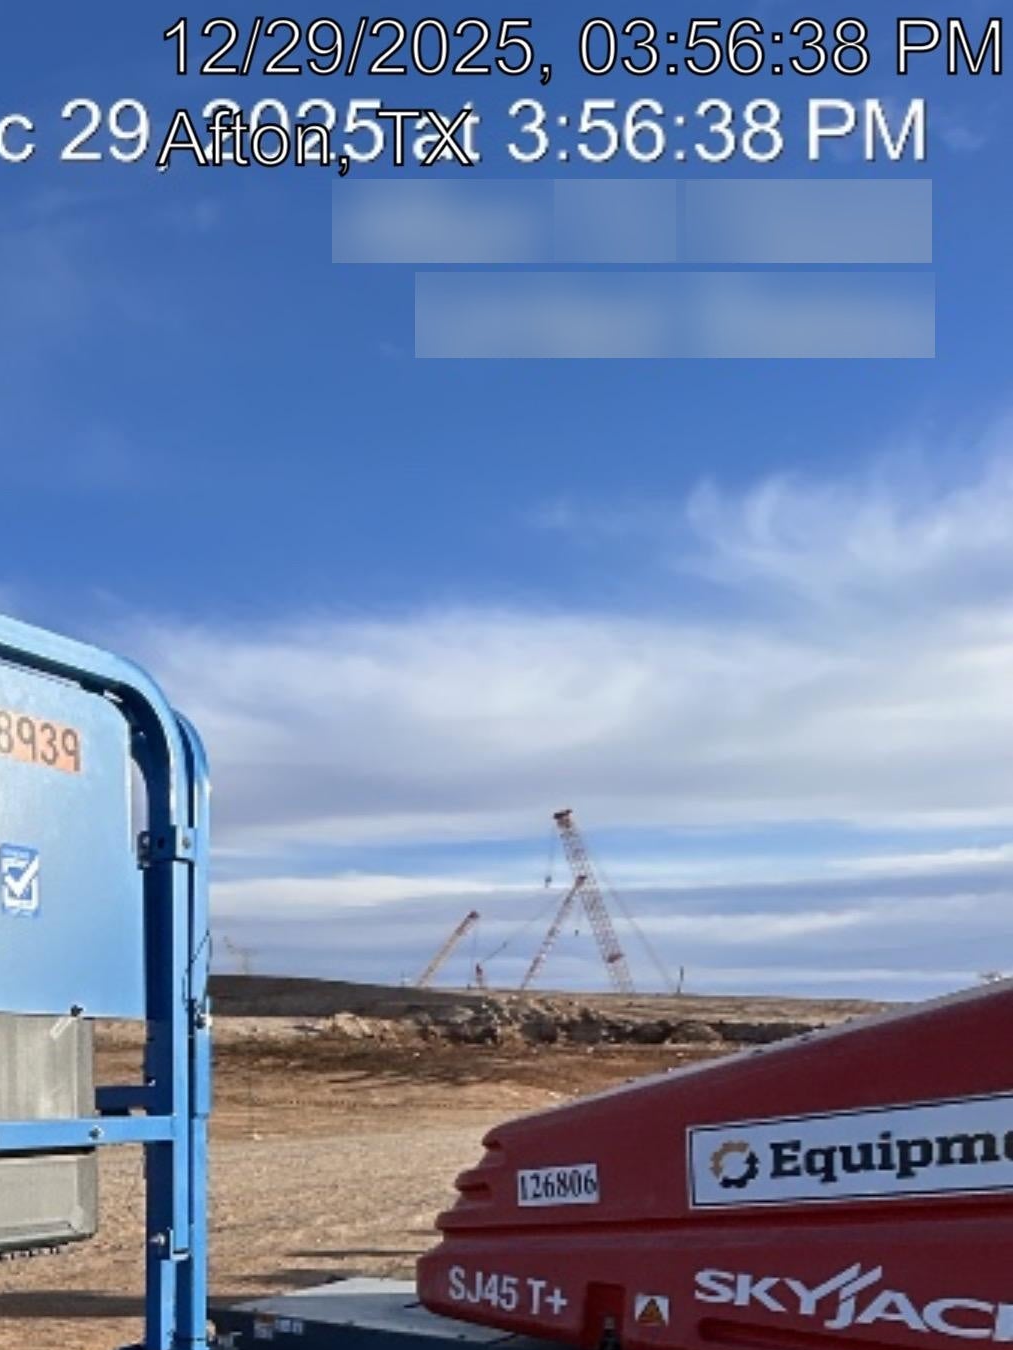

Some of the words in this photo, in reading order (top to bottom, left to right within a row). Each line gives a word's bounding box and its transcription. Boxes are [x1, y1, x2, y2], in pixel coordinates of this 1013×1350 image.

[520, 1165, 598, 1202] 126806
[448, 1265, 518, 1311] SJ45
[527, 1277, 568, 1316] T+
